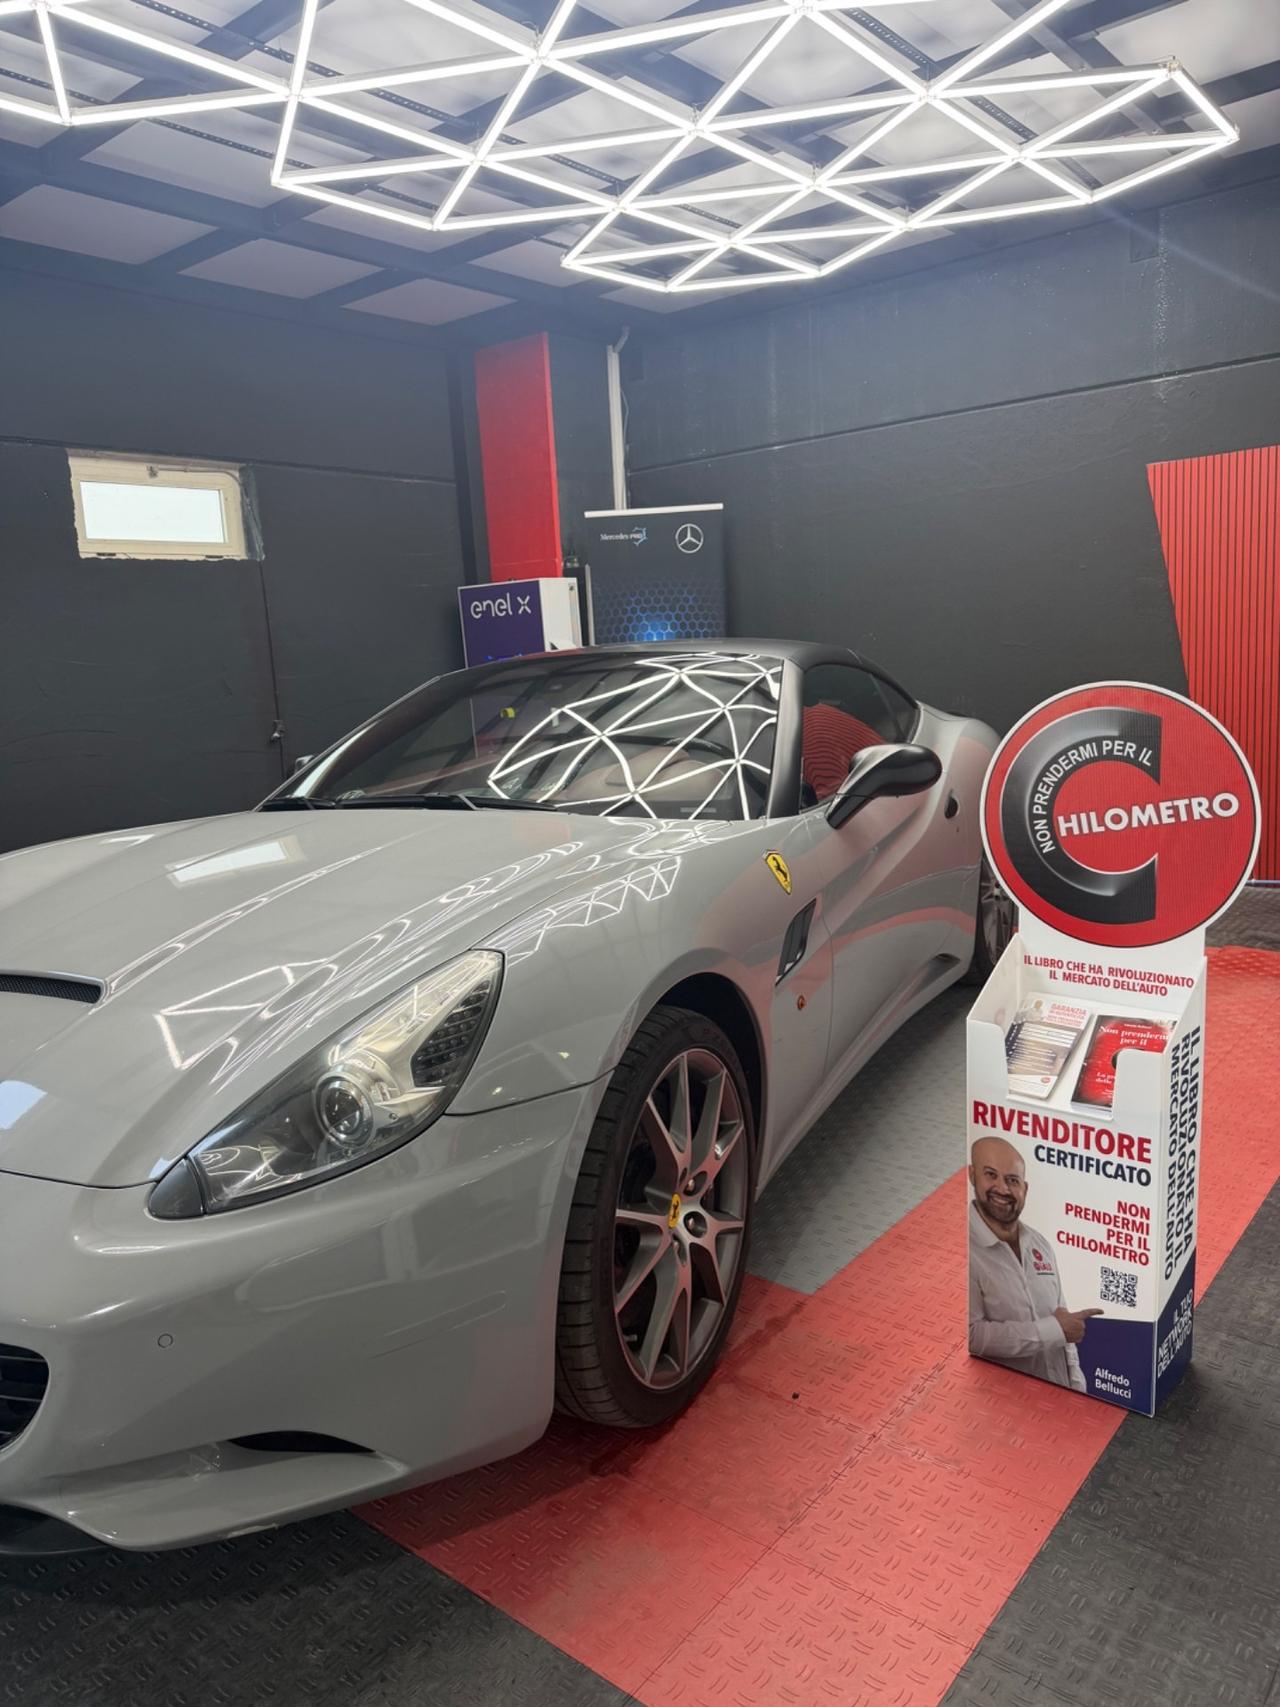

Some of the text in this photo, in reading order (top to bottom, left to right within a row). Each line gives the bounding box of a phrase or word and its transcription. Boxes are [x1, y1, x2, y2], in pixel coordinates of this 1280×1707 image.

[470, 593, 512, 619] enel
[1033, 740, 1152, 854] NON PRENDERMI PER IL
[1024, 955, 1195, 988] IL LIBRO CHE HA RIVOLUZIONATO
[1049, 970, 1168, 997] IL MERCATO DELL'AUTO
[973, 1101, 1152, 1164] RIVENDITORE
[1184, 1025, 1200, 1254] IL LIBRO CHE HA
[1034, 1145, 1152, 1187] CERTIFICATO
[1165, 1043, 1181, 1280] MERCATO DELL'AUTO
[1174, 1032, 1191, 1268] RIVOLUZIONATO IL
[1065, 1202, 1150, 1236] PRENDERMI
[1117, 1200, 1150, 1220] NON
[1056, 1230, 1149, 1266] CHILOMETRO
[1106, 1228, 1151, 1252] PER IL
[1095, 1367, 1130, 1387] Alfredo
[1095, 1378, 1132, 1399] Bellucci
